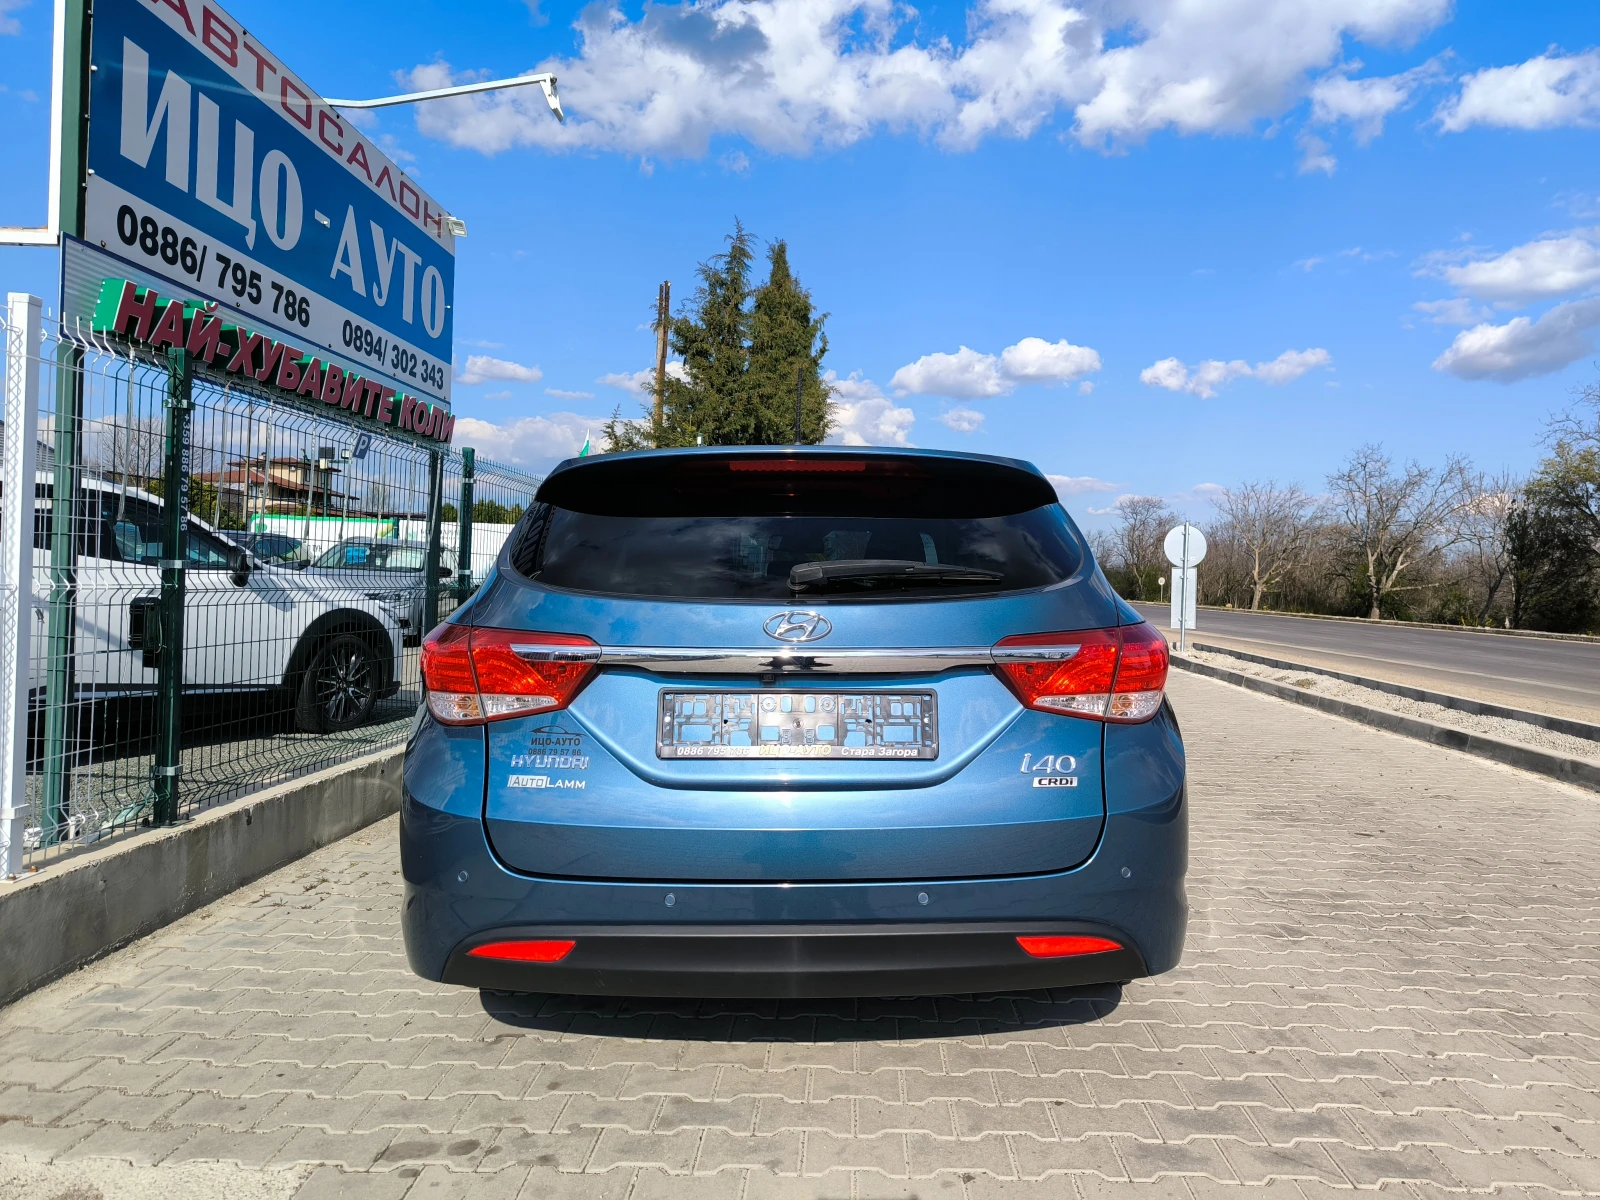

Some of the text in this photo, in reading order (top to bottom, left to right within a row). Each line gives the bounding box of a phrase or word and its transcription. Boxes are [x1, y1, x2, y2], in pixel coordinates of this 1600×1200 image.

[116, 205, 311, 328] 0886/ 795 786
[112, 279, 456, 444] НАЙ-ХУБАВИТЕ КОЛИ
[342, 319, 444, 390] 0894/ 302 343
[180, 413, 191, 531] +359 886 79 57 86
[528, 748, 582, 756] 0886 79 57 86
[530, 737, 581, 747] ИЦО-АУТО
[677, 746, 704, 756] 0886
[707, 746, 727, 756] 795
[841, 746, 875, 757] Стара
[878, 747, 918, 758] Загора
[510, 754, 589, 770] HYUNDAI
[1020, 752, 1077, 774] i40
